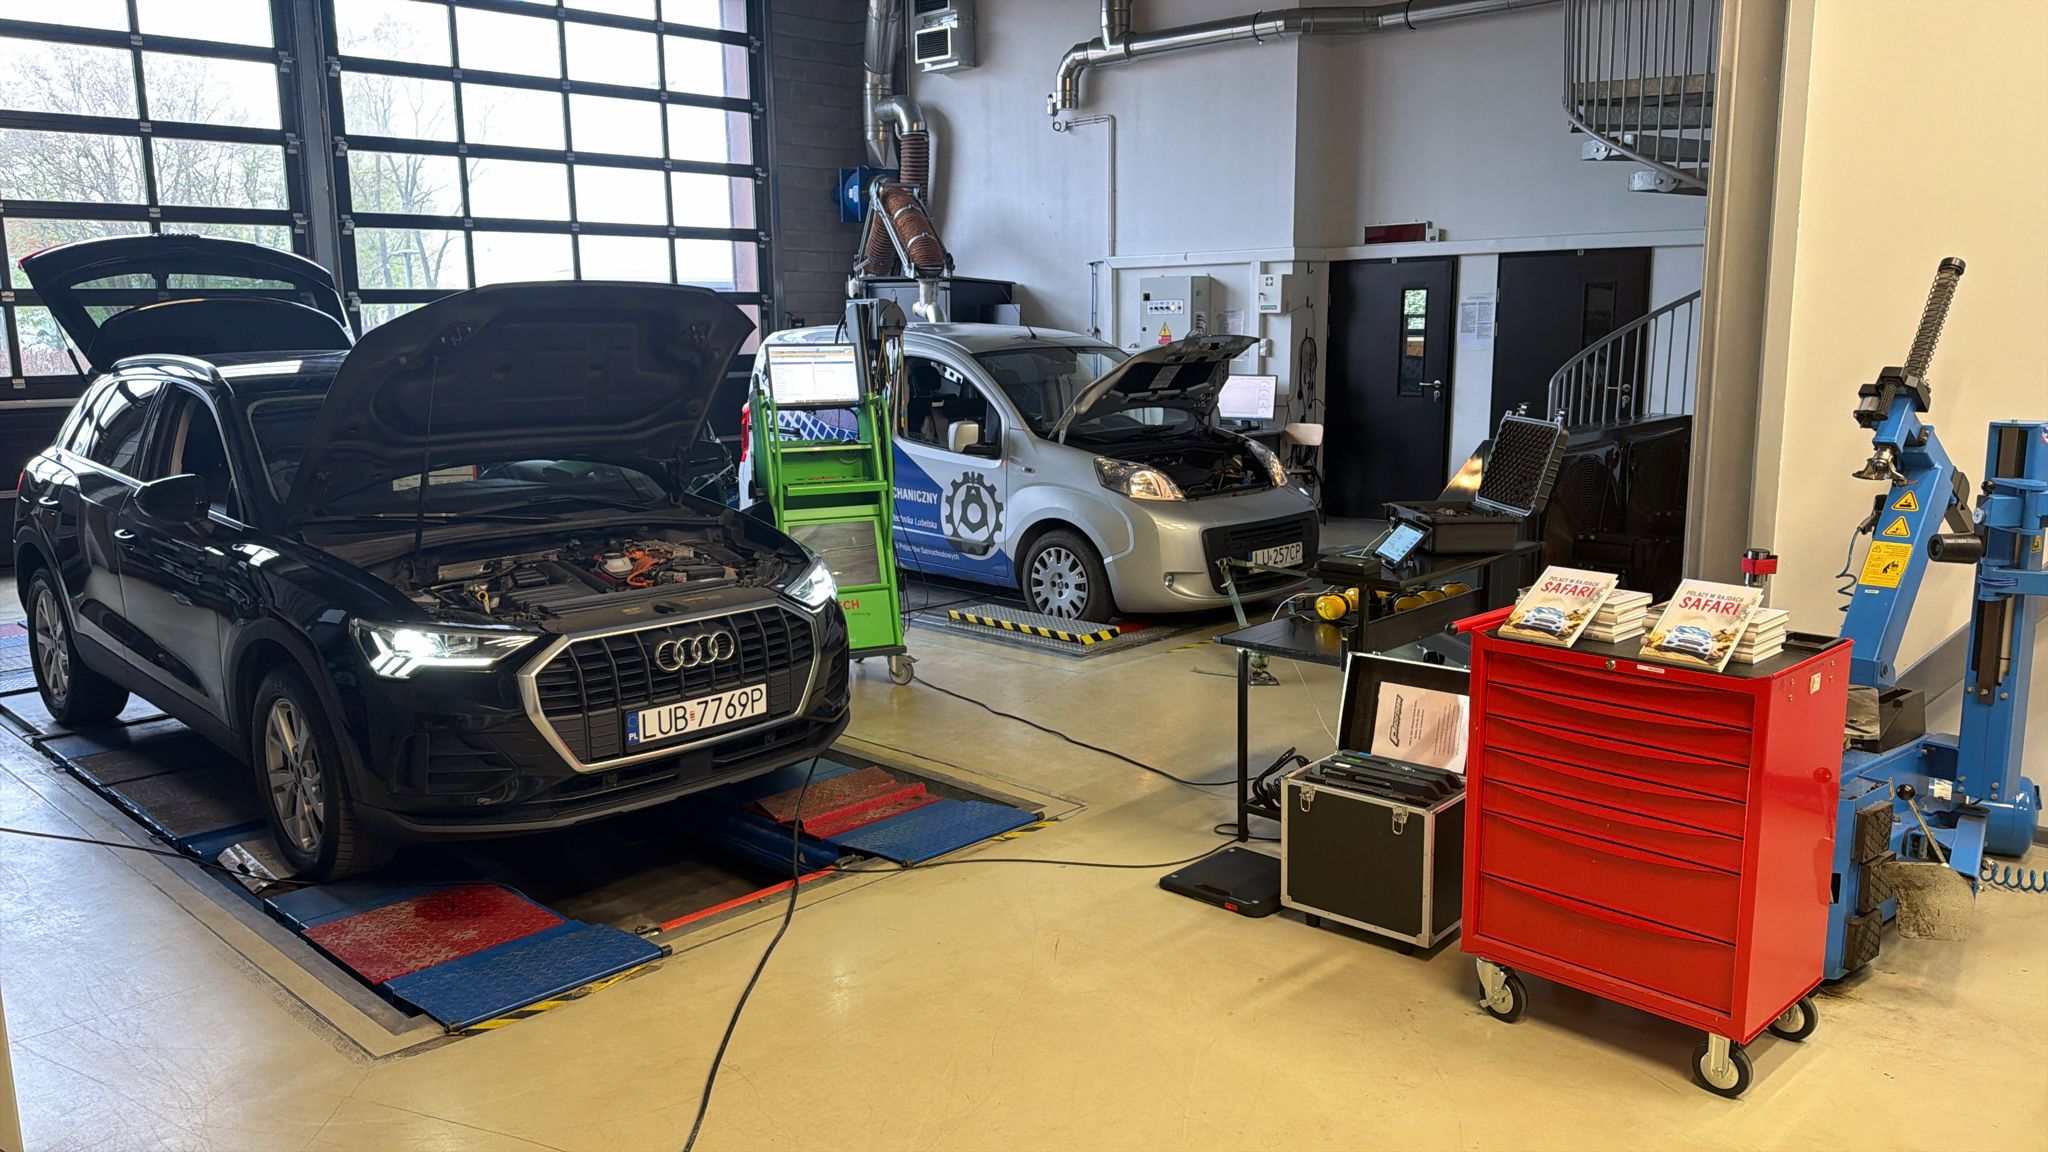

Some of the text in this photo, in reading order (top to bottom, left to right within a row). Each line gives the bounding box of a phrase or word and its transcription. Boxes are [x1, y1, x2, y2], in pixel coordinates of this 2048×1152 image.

[1273, 543, 1301, 564] 257CP
[1540, 581, 1596, 598] SAFARI
[1686, 590, 1710, 598] POLACY
[1717, 594, 1745, 603] RAJDACH
[1678, 596, 1741, 616] SAFARI
[641, 688, 763, 740] LUB 7769P
[628, 733, 639, 741] PL
